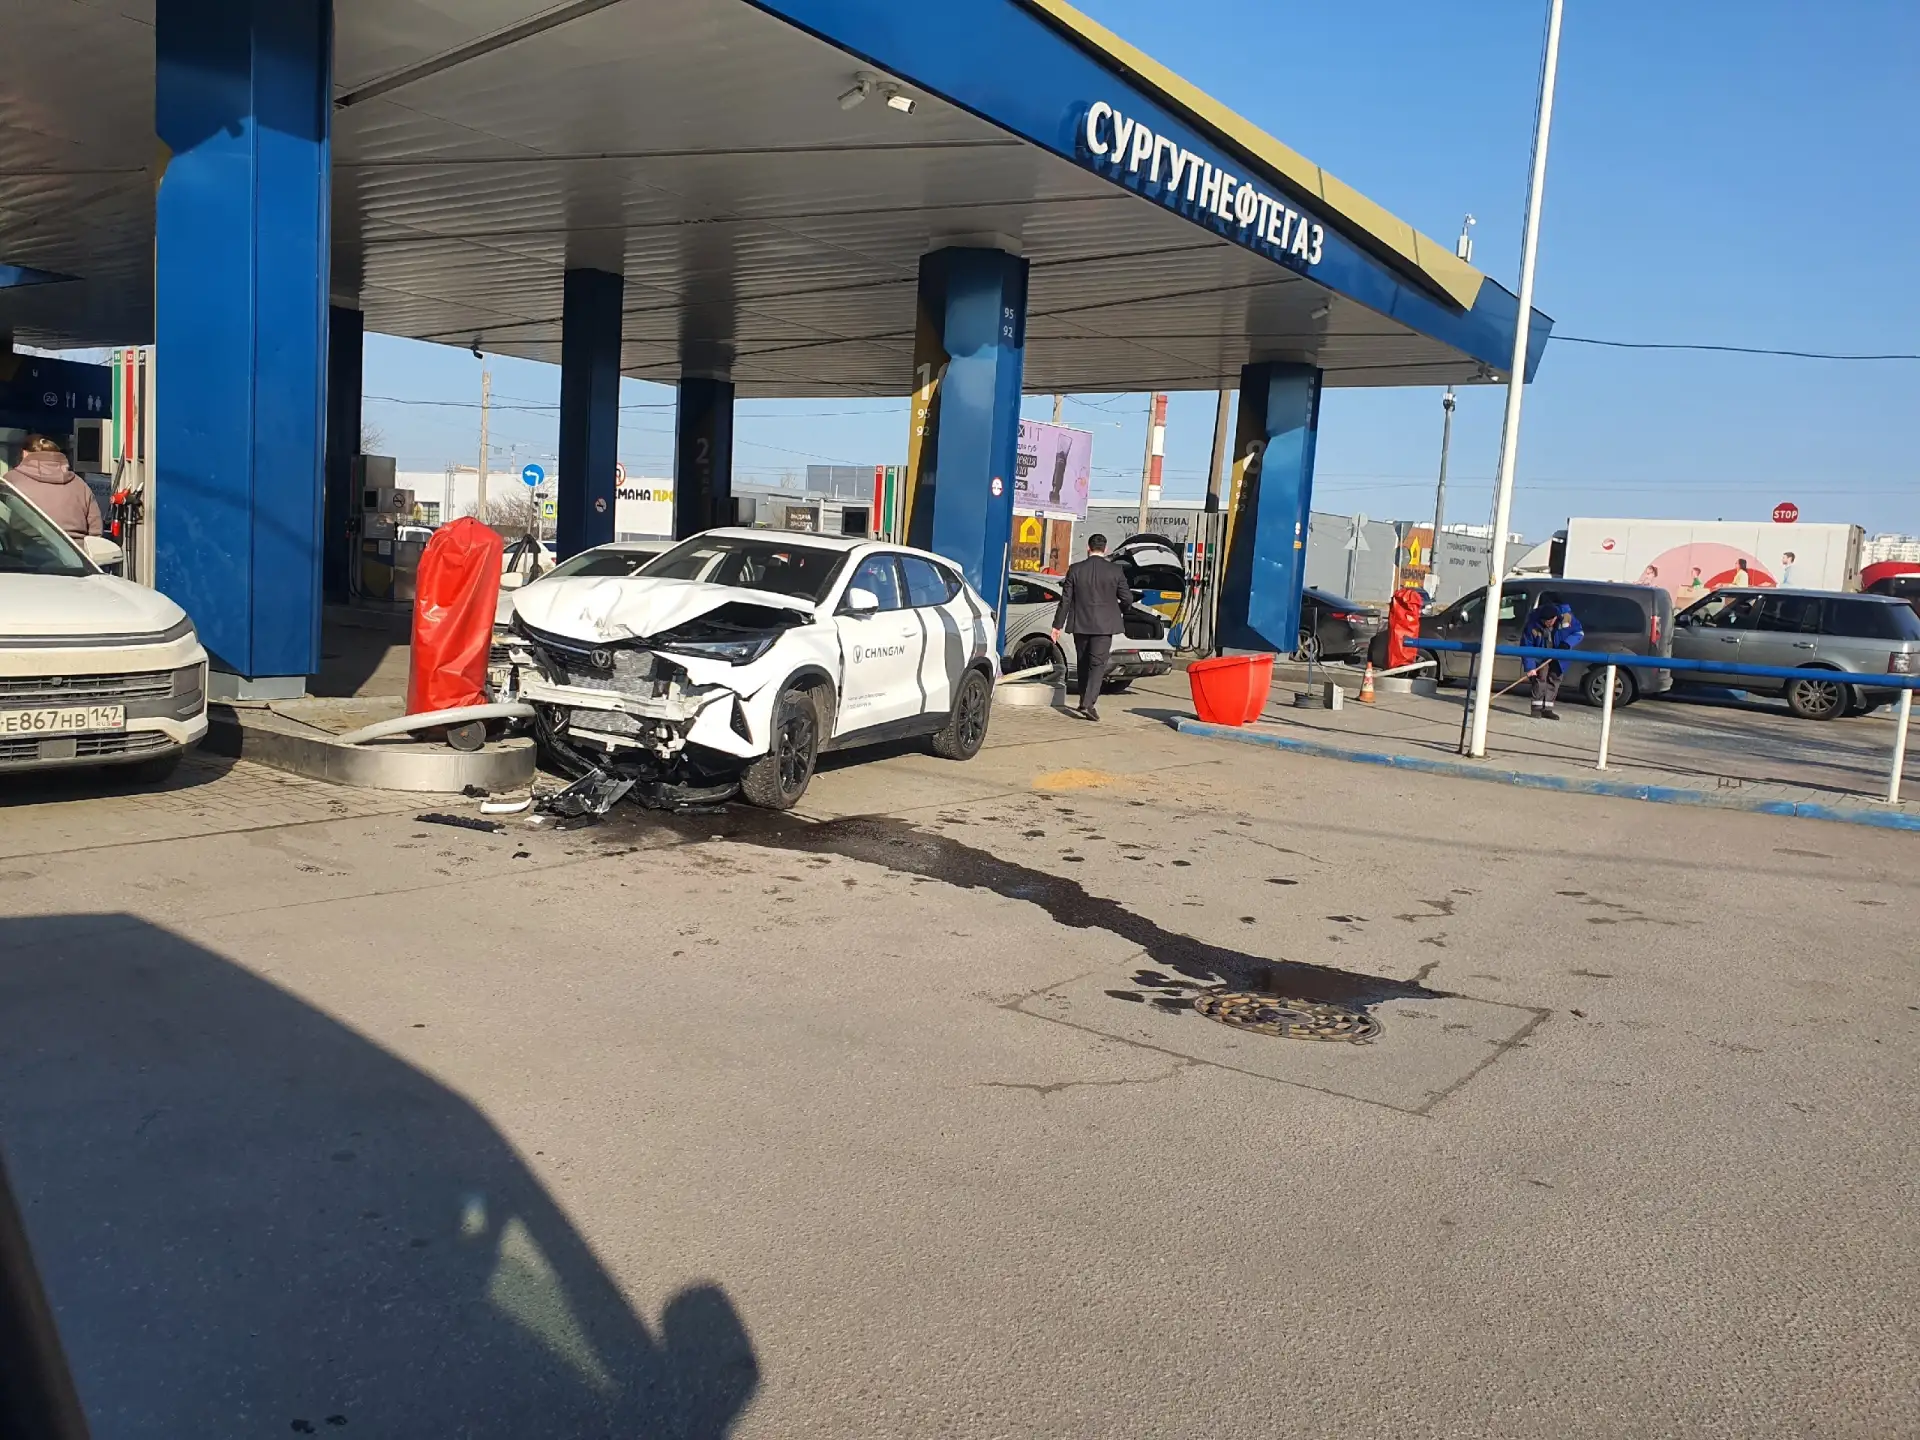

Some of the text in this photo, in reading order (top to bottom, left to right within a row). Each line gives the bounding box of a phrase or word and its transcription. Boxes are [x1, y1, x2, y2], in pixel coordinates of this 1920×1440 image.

[1086, 101, 1324, 266] СУРГУТНЕФТЕГАЗ
[1004, 307, 1014, 320] 95
[1003, 325, 1013, 338] 92
[917, 408, 931, 419] 95
[916, 425, 930, 437] 92
[696, 437, 710, 464] 2
[1116, 515, 1189, 526] СТРОМАТЕРИА
[1774, 510, 1797, 519] STOP
[865, 645, 905, 658] CHANGAN
[91, 707, 119, 721] 147
